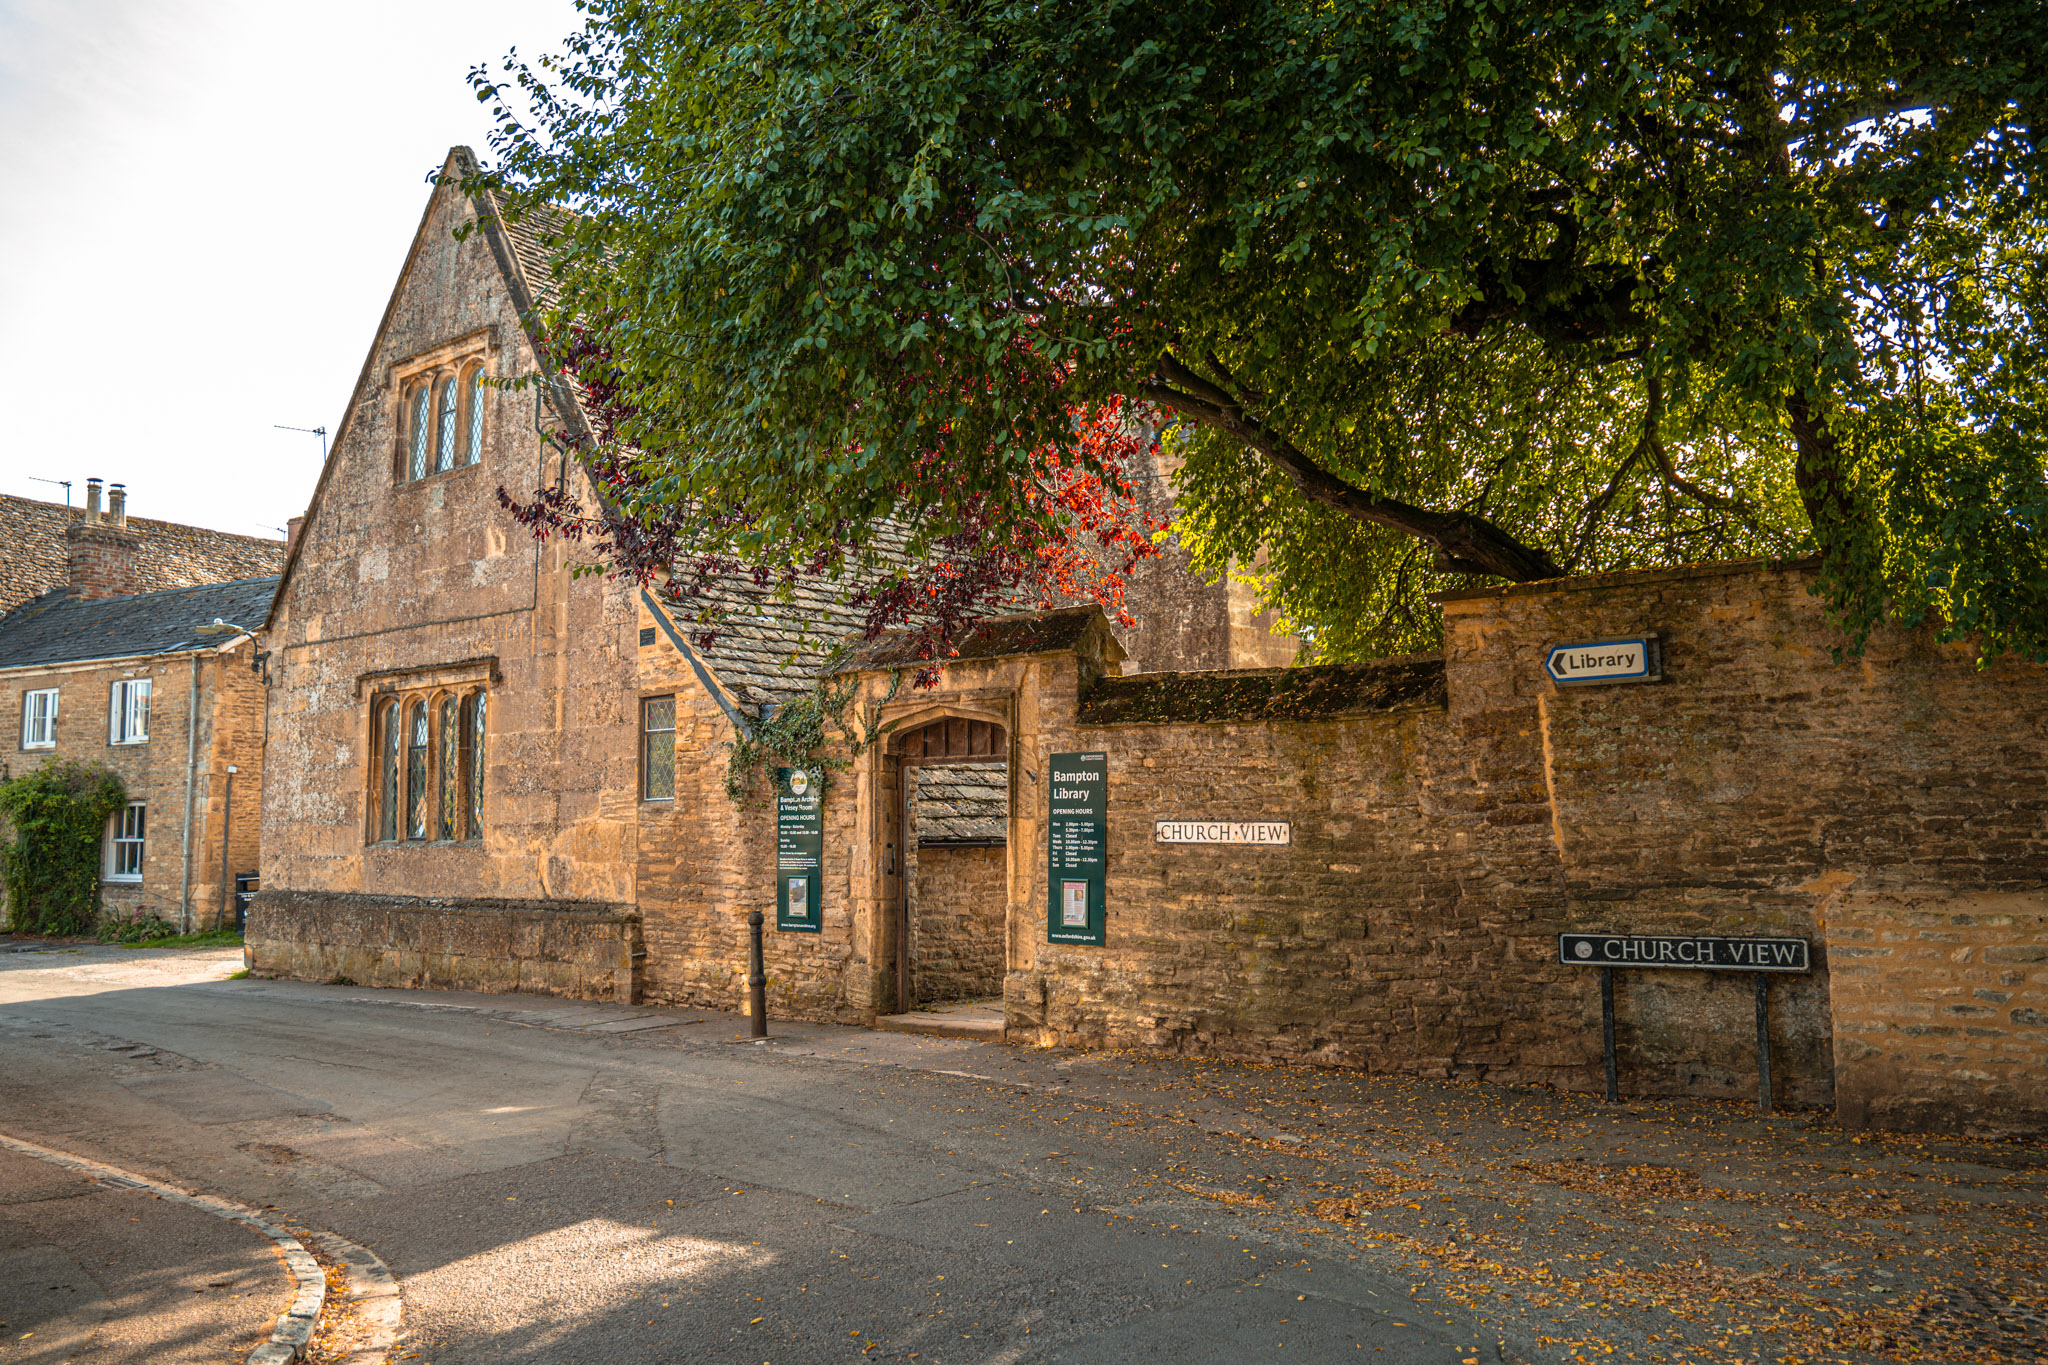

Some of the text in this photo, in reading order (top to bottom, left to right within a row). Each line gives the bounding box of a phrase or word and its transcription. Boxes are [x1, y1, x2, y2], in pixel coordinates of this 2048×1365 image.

[1569, 653, 1636, 669] Library
[1053, 770, 1100, 785] Bampton
[1053, 787, 1090, 802] Library
[1161, 824, 1283, 841] CHURCH VIEW
[1603, 940, 1798, 965] CHURCH VIEW
